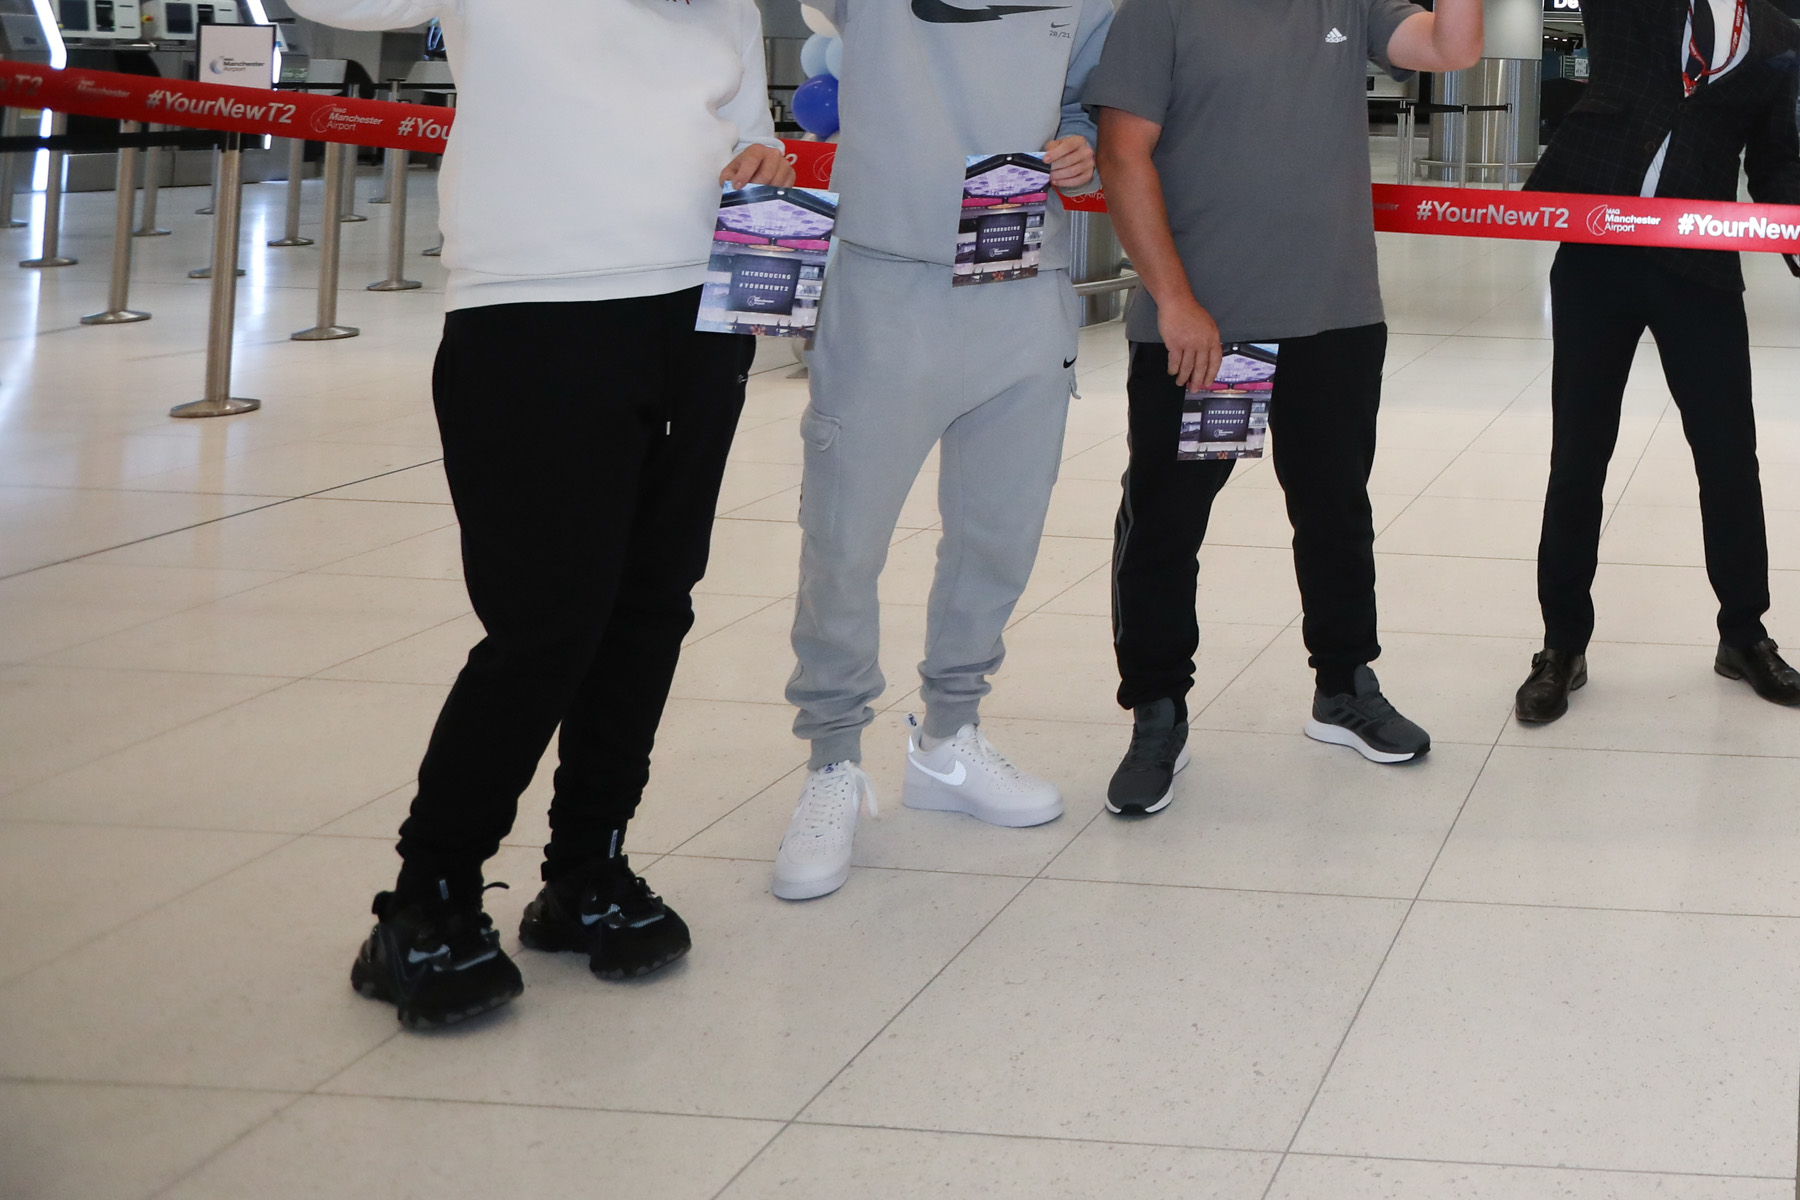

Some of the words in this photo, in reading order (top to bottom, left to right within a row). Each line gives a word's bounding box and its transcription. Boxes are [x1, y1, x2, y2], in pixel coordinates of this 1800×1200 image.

[146, 89, 296, 124] #YourNewT2
[329, 113, 383, 126] Manchester
[326, 122, 356, 131] Airport
[1416, 200, 1569, 229] #YourNewT2
[1604, 214, 1661, 226] Manchester
[1604, 222, 1635, 233] Airport
[741, 270, 791, 280] INTRODUCING
